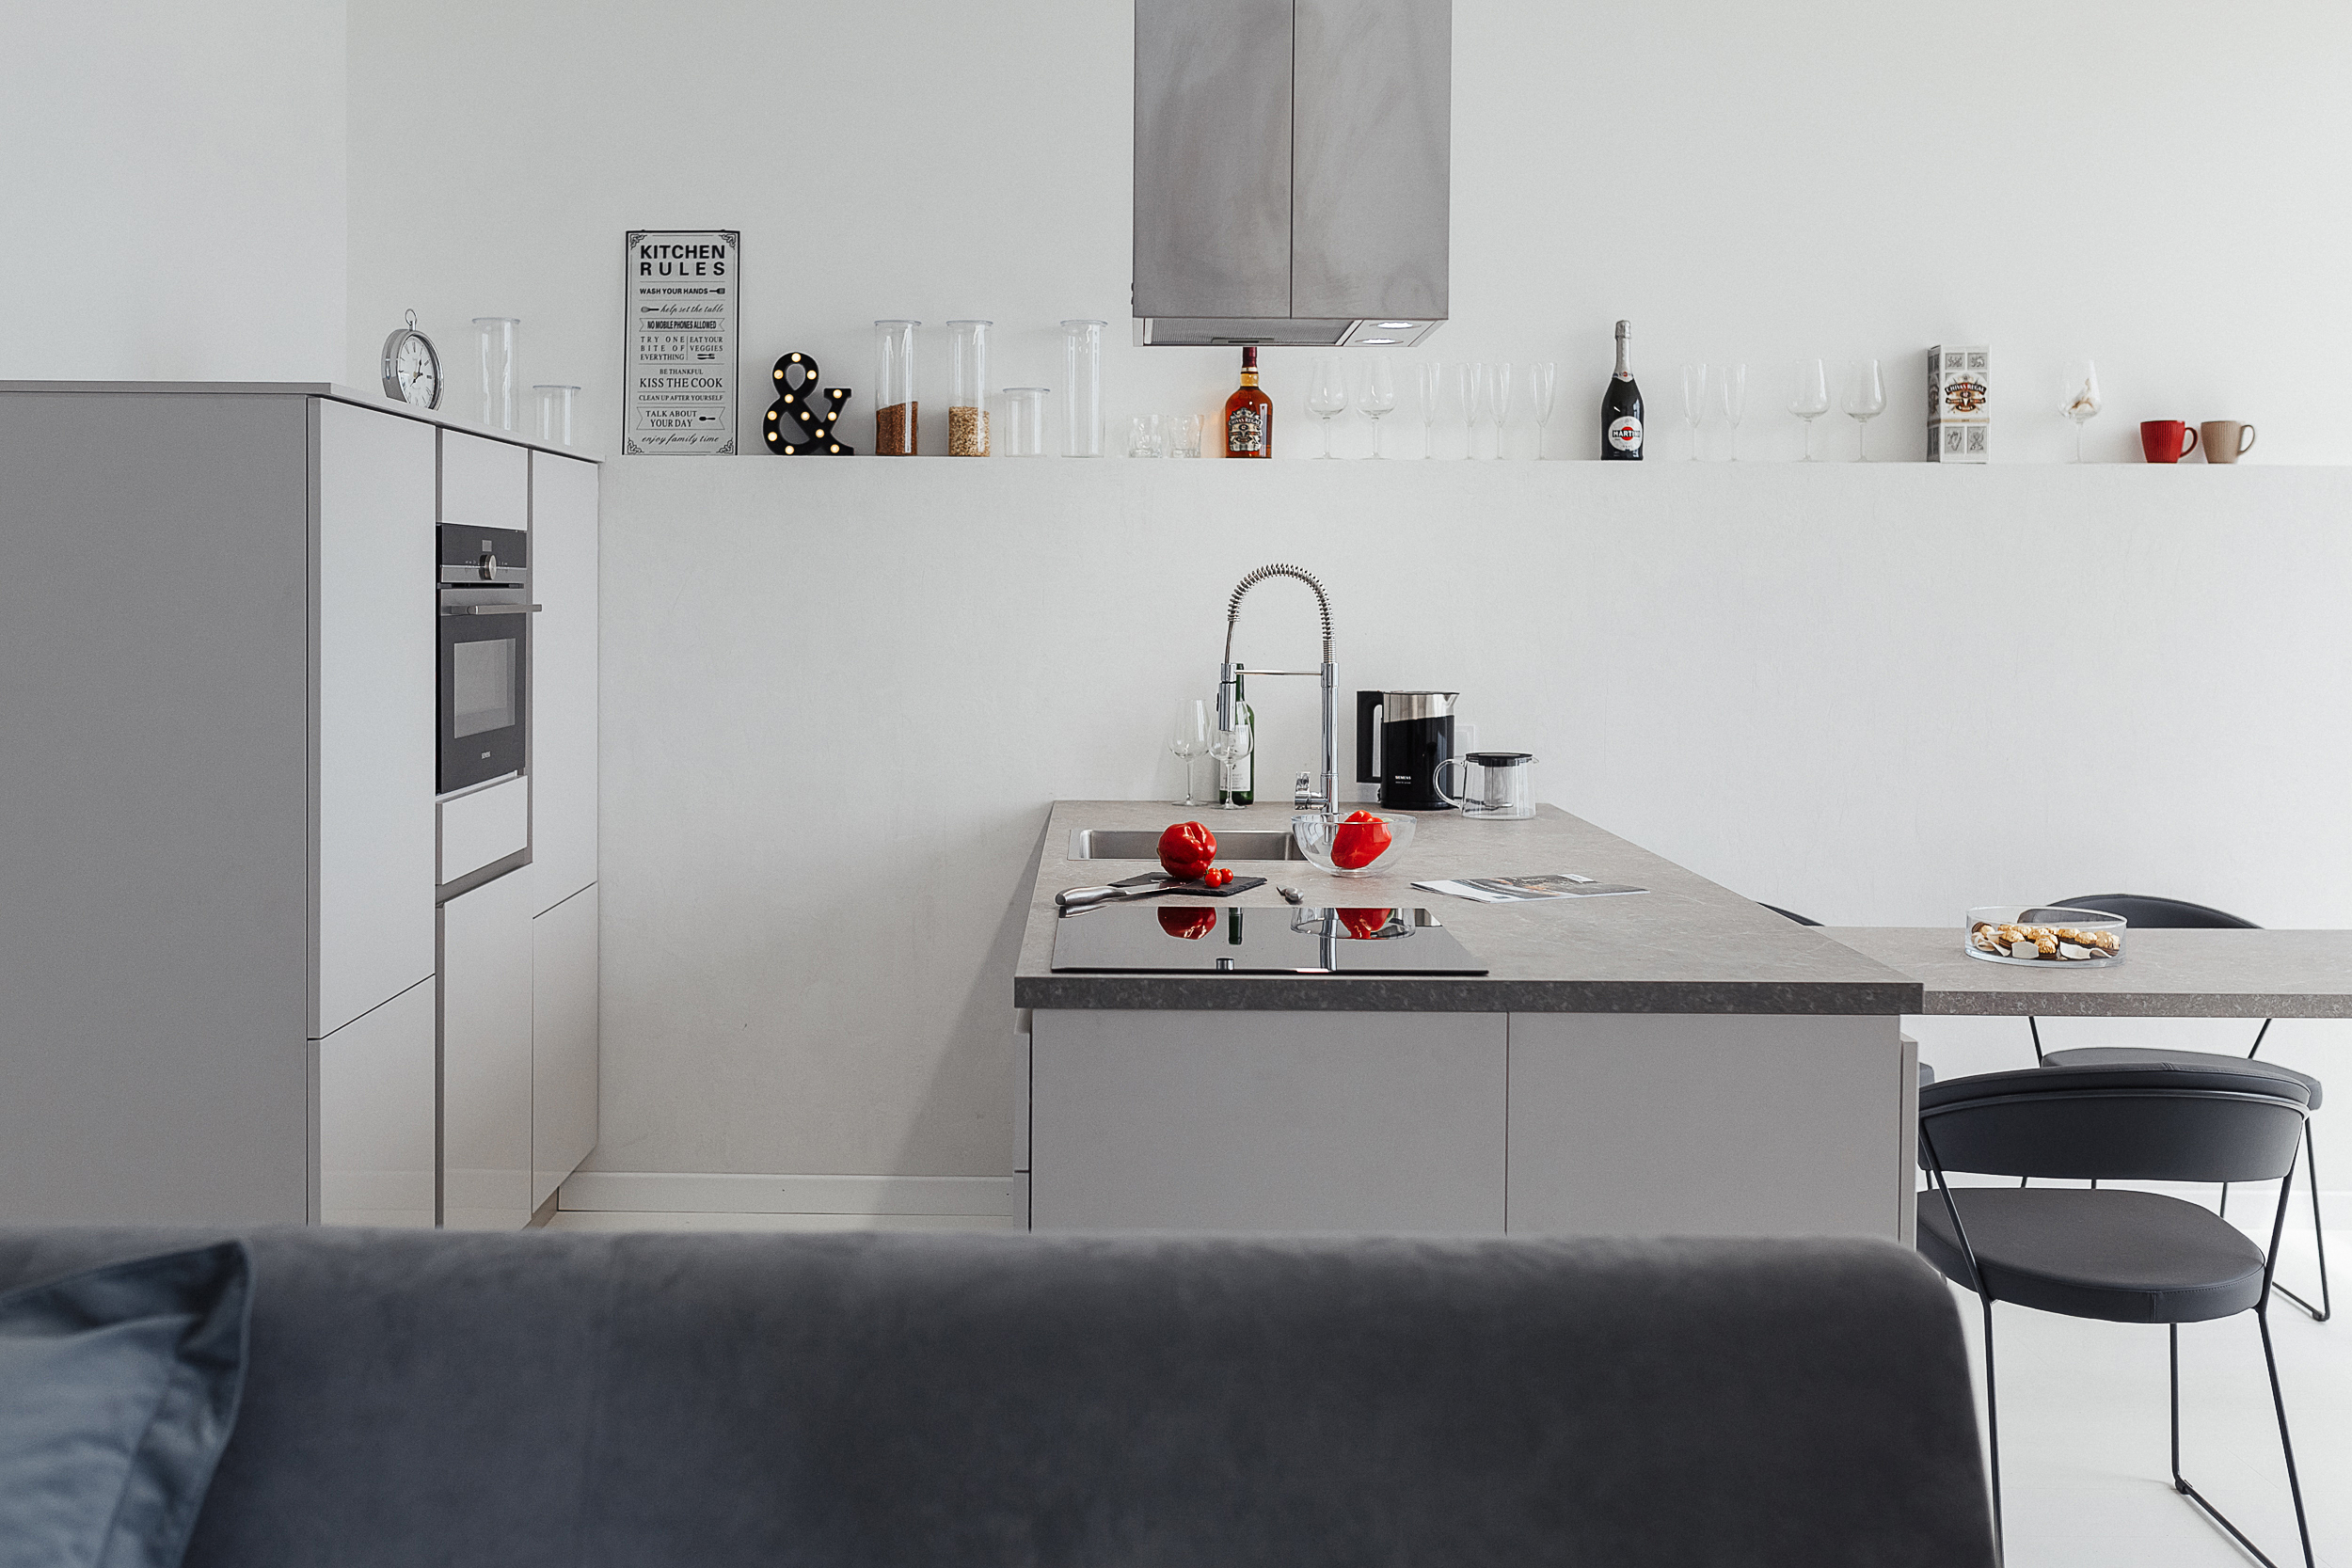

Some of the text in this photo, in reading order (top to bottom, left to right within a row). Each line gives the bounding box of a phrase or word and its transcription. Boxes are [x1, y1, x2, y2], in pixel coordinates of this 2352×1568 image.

[640, 245, 725, 260] KITCHEN
[640, 261, 725, 277] RULES
[660, 304, 677, 315] help
[691, 304, 703, 313] the
[704, 303, 723, 313] table
[647, 321, 717, 329] NO MOBILE PHONES ALLOWED
[640, 377, 723, 388] KISS THE COOK
[650, 419, 693, 427] YOUR DAY
[642, 436, 666, 445] enjoy
[665, 433, 697, 445] family
